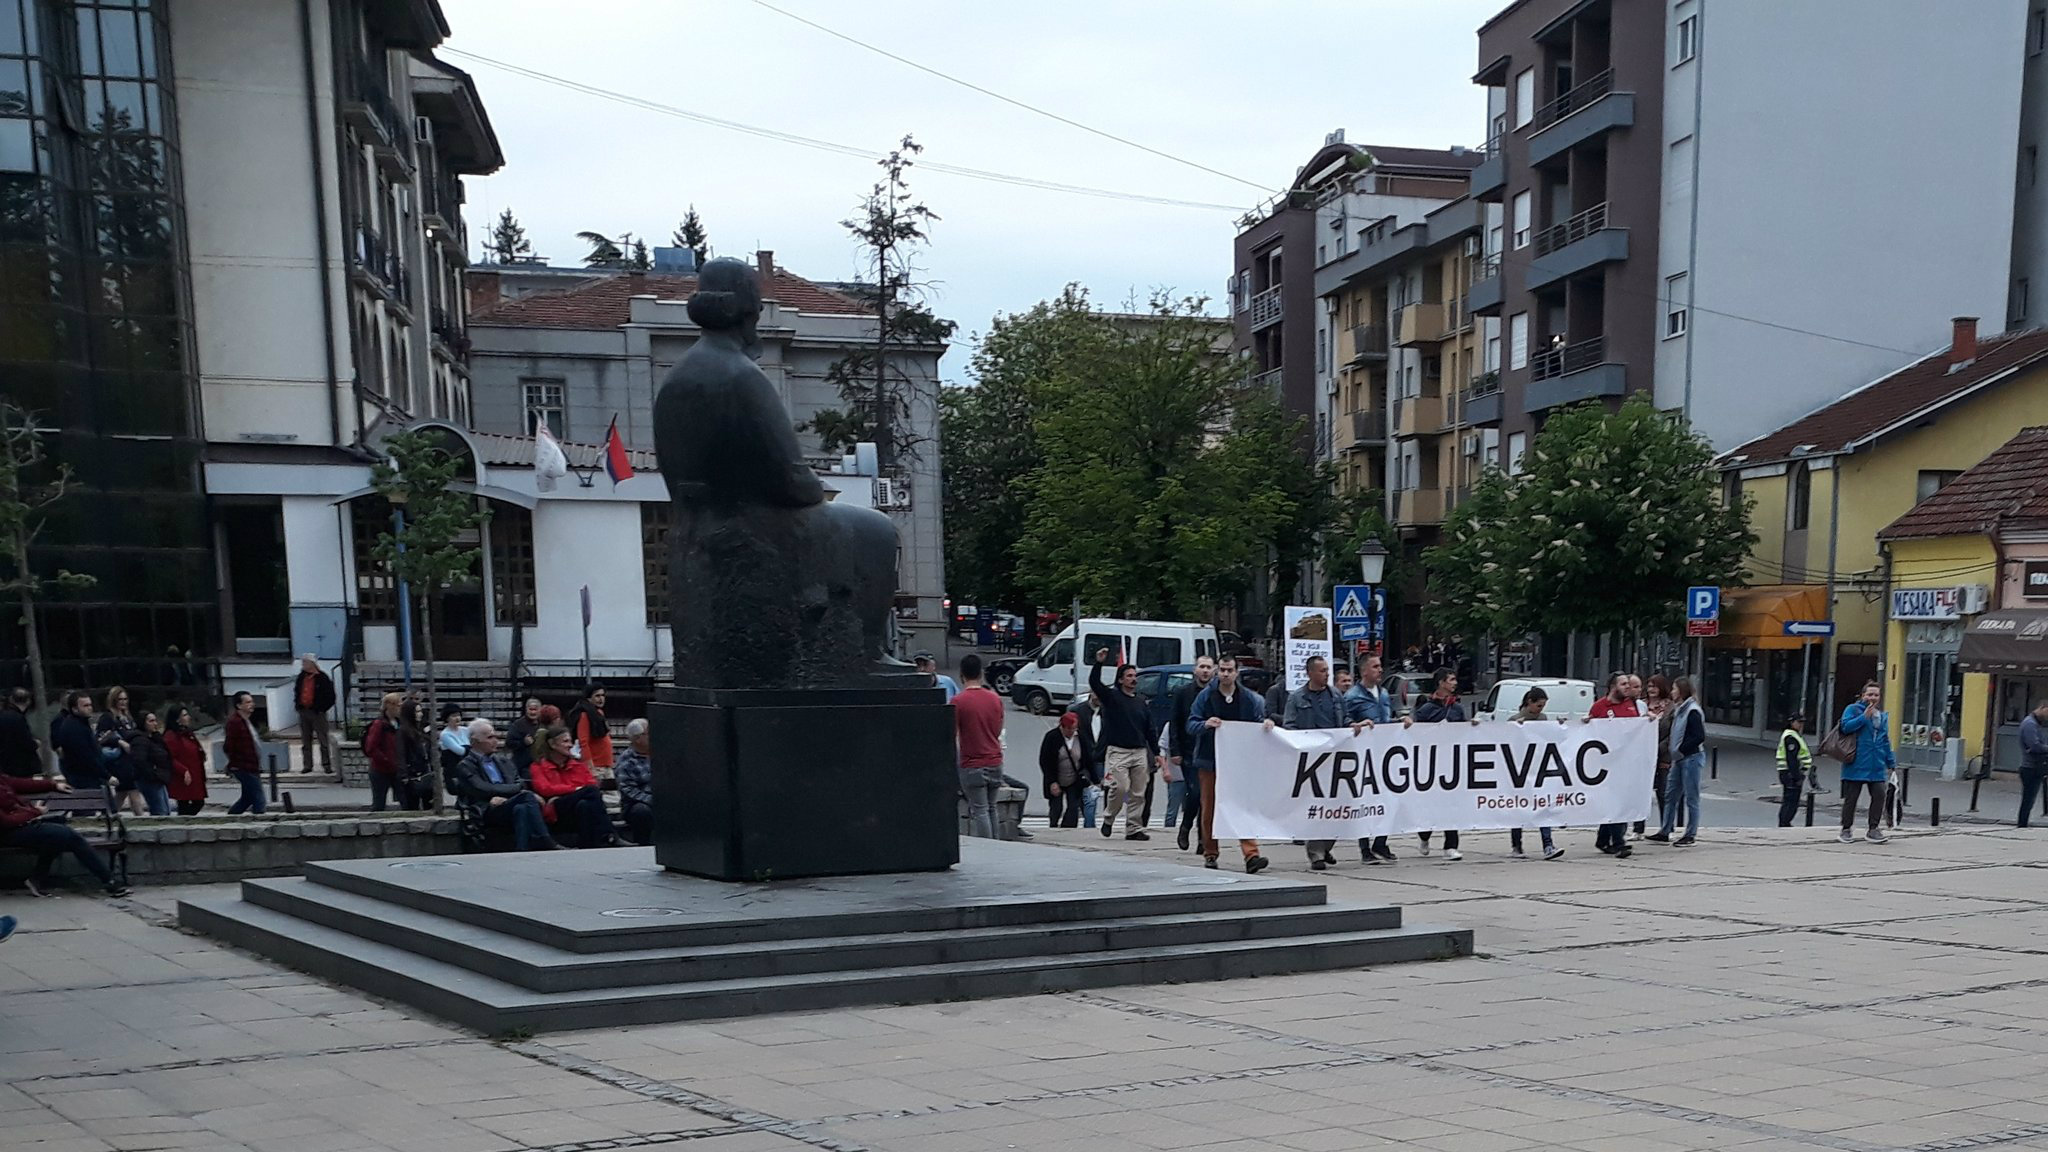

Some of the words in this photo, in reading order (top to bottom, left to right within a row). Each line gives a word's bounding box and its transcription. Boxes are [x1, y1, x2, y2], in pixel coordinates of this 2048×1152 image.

[1695, 591, 1713, 615] P
[1892, 592, 1936, 616] MESARA
[1291, 740, 1609, 798] KRAGUJEVAC
[1307, 804, 1385, 819] #1od5mona
[1477, 794, 1529, 809] Počelo
[1533, 794, 1551, 811] je!
[1555, 792, 1586, 806] #KG
